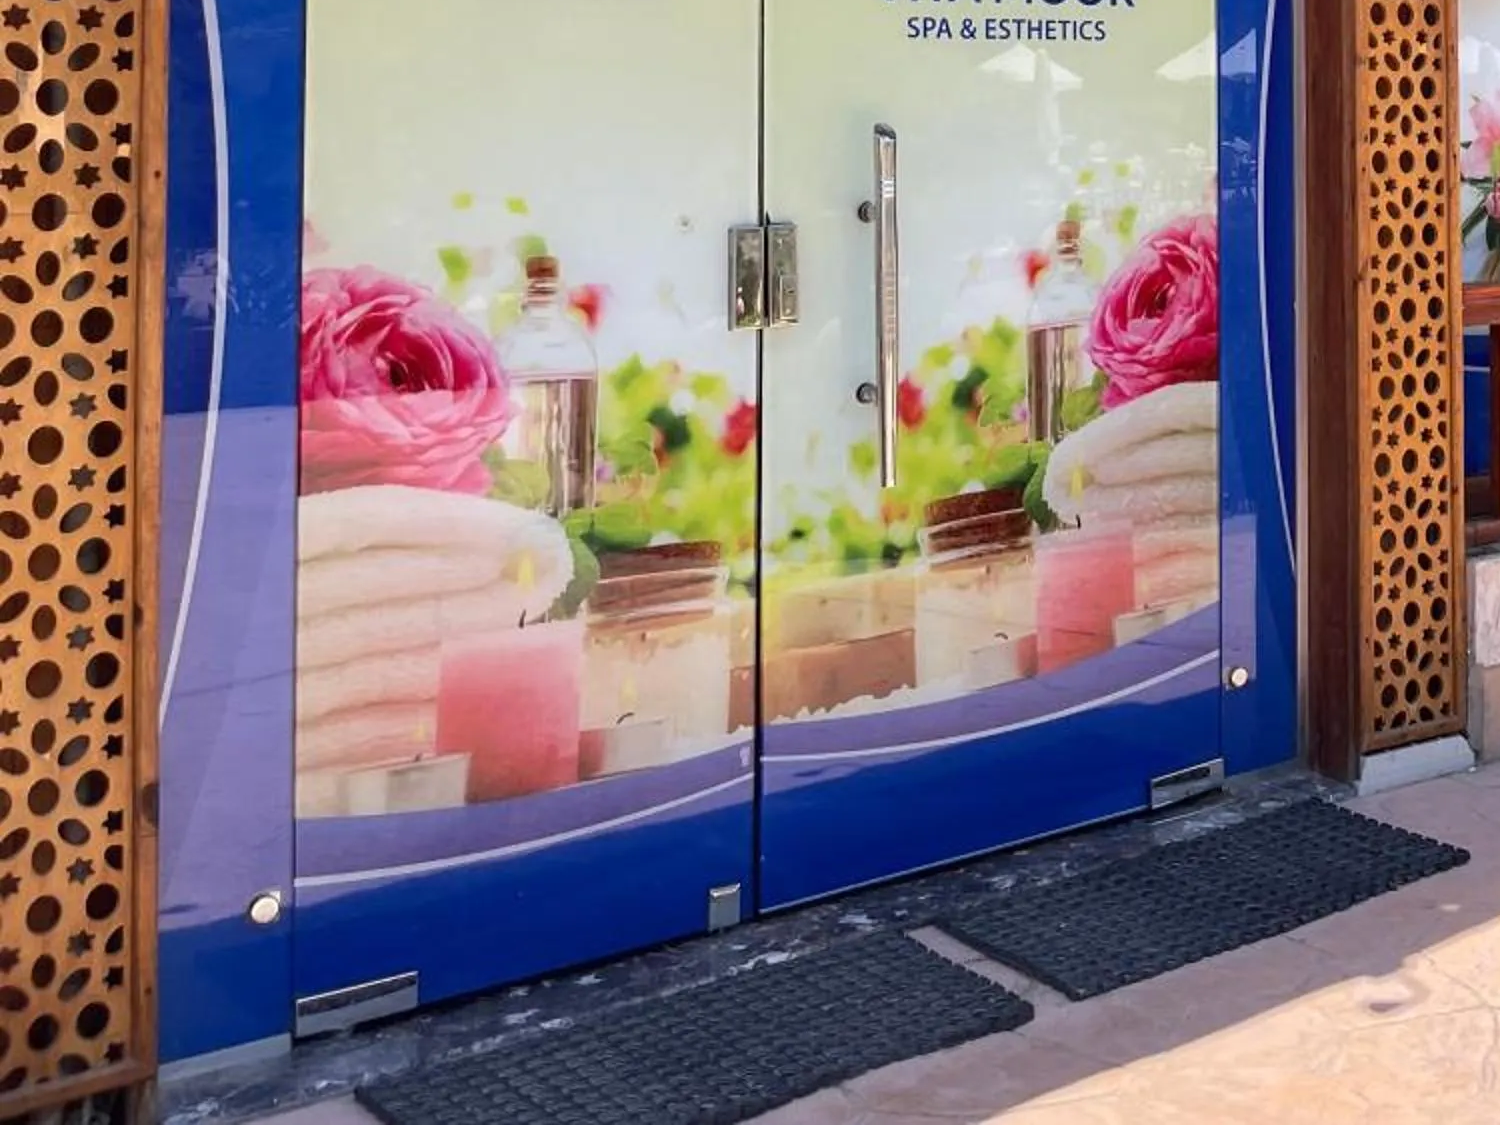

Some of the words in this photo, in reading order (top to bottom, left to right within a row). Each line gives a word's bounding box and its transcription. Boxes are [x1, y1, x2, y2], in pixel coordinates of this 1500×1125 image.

[907, 16, 953, 40] SPA
[960, 18, 977, 40] &
[985, 18, 1107, 42] ESTHETICS
